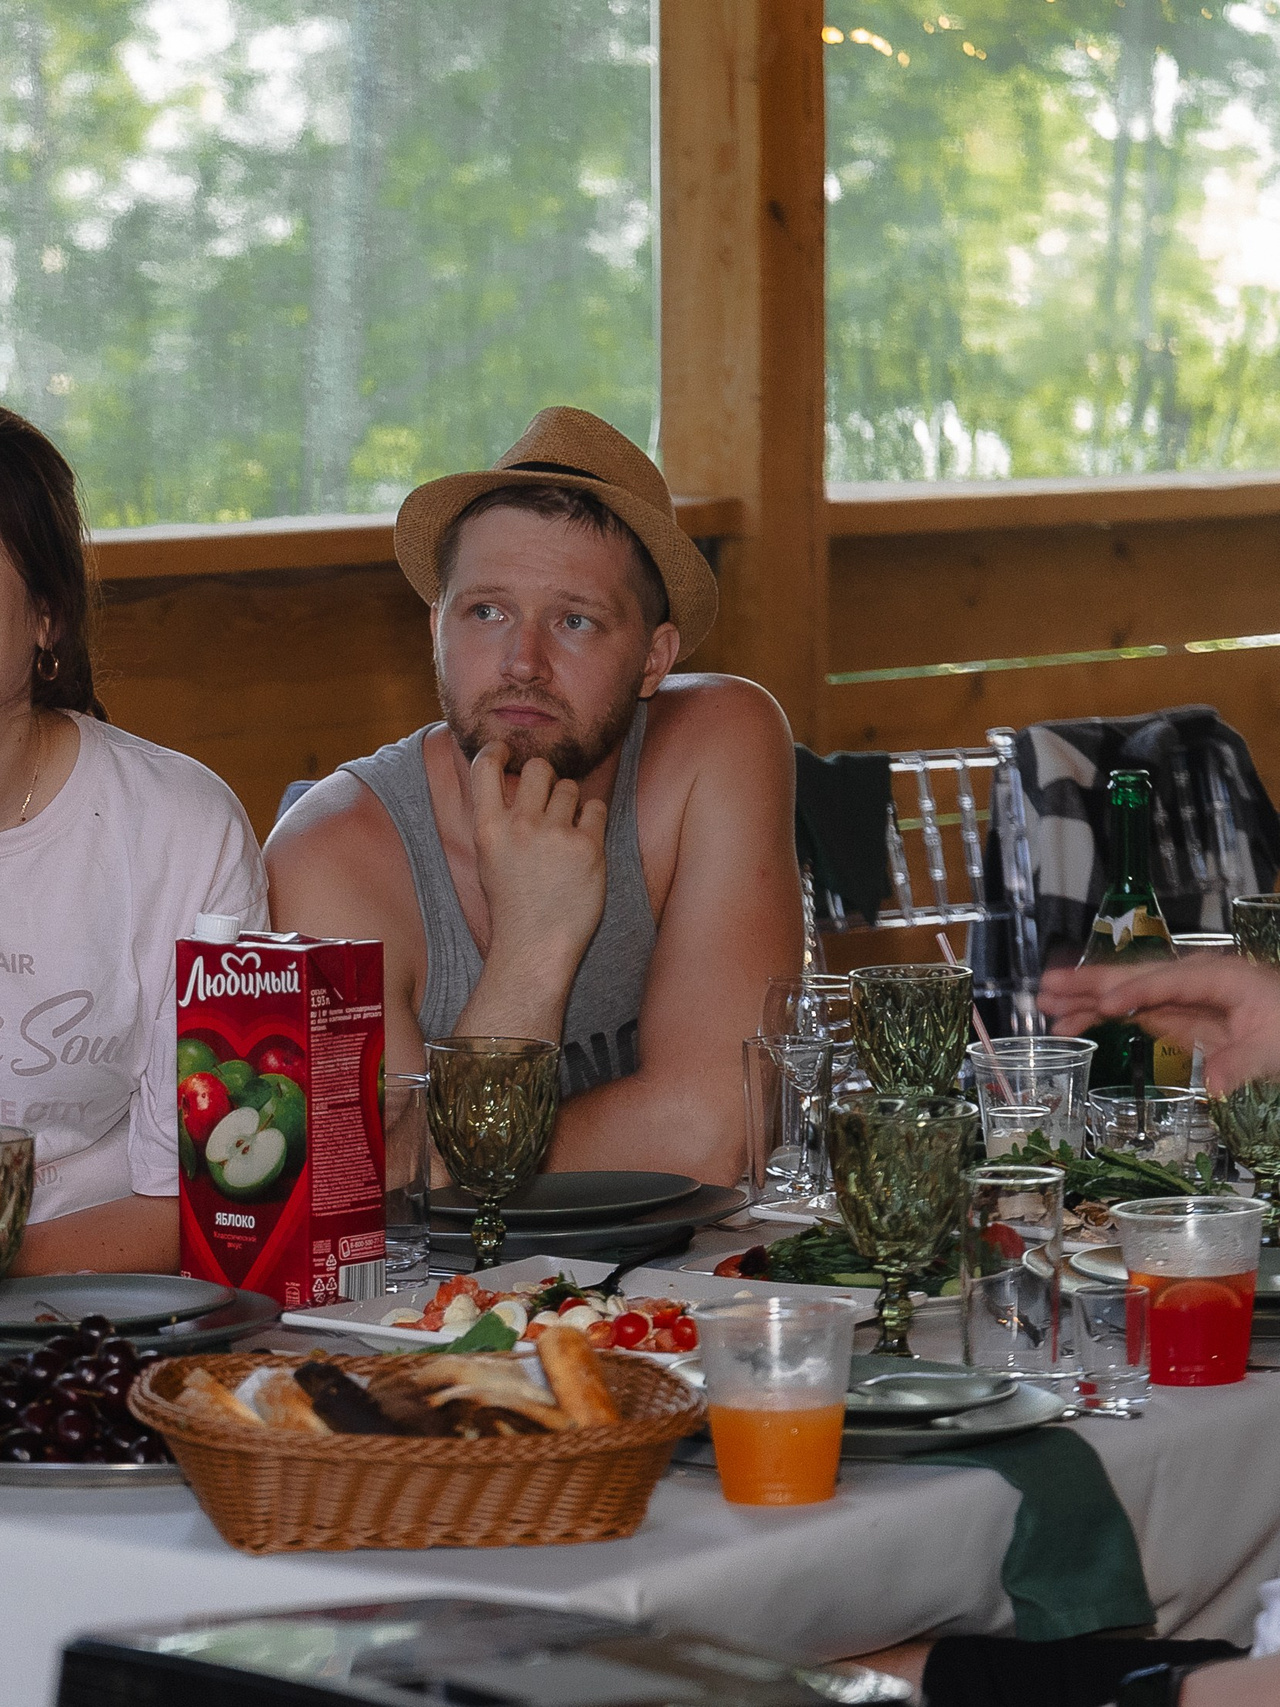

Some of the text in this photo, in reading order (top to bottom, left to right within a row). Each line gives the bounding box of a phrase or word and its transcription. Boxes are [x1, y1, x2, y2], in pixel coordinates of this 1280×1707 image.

[178, 951, 301, 1007] Любимый
[23, 1100, 94, 1126] CITY
[215, 1212, 256, 1229] ЯБЛОКО
